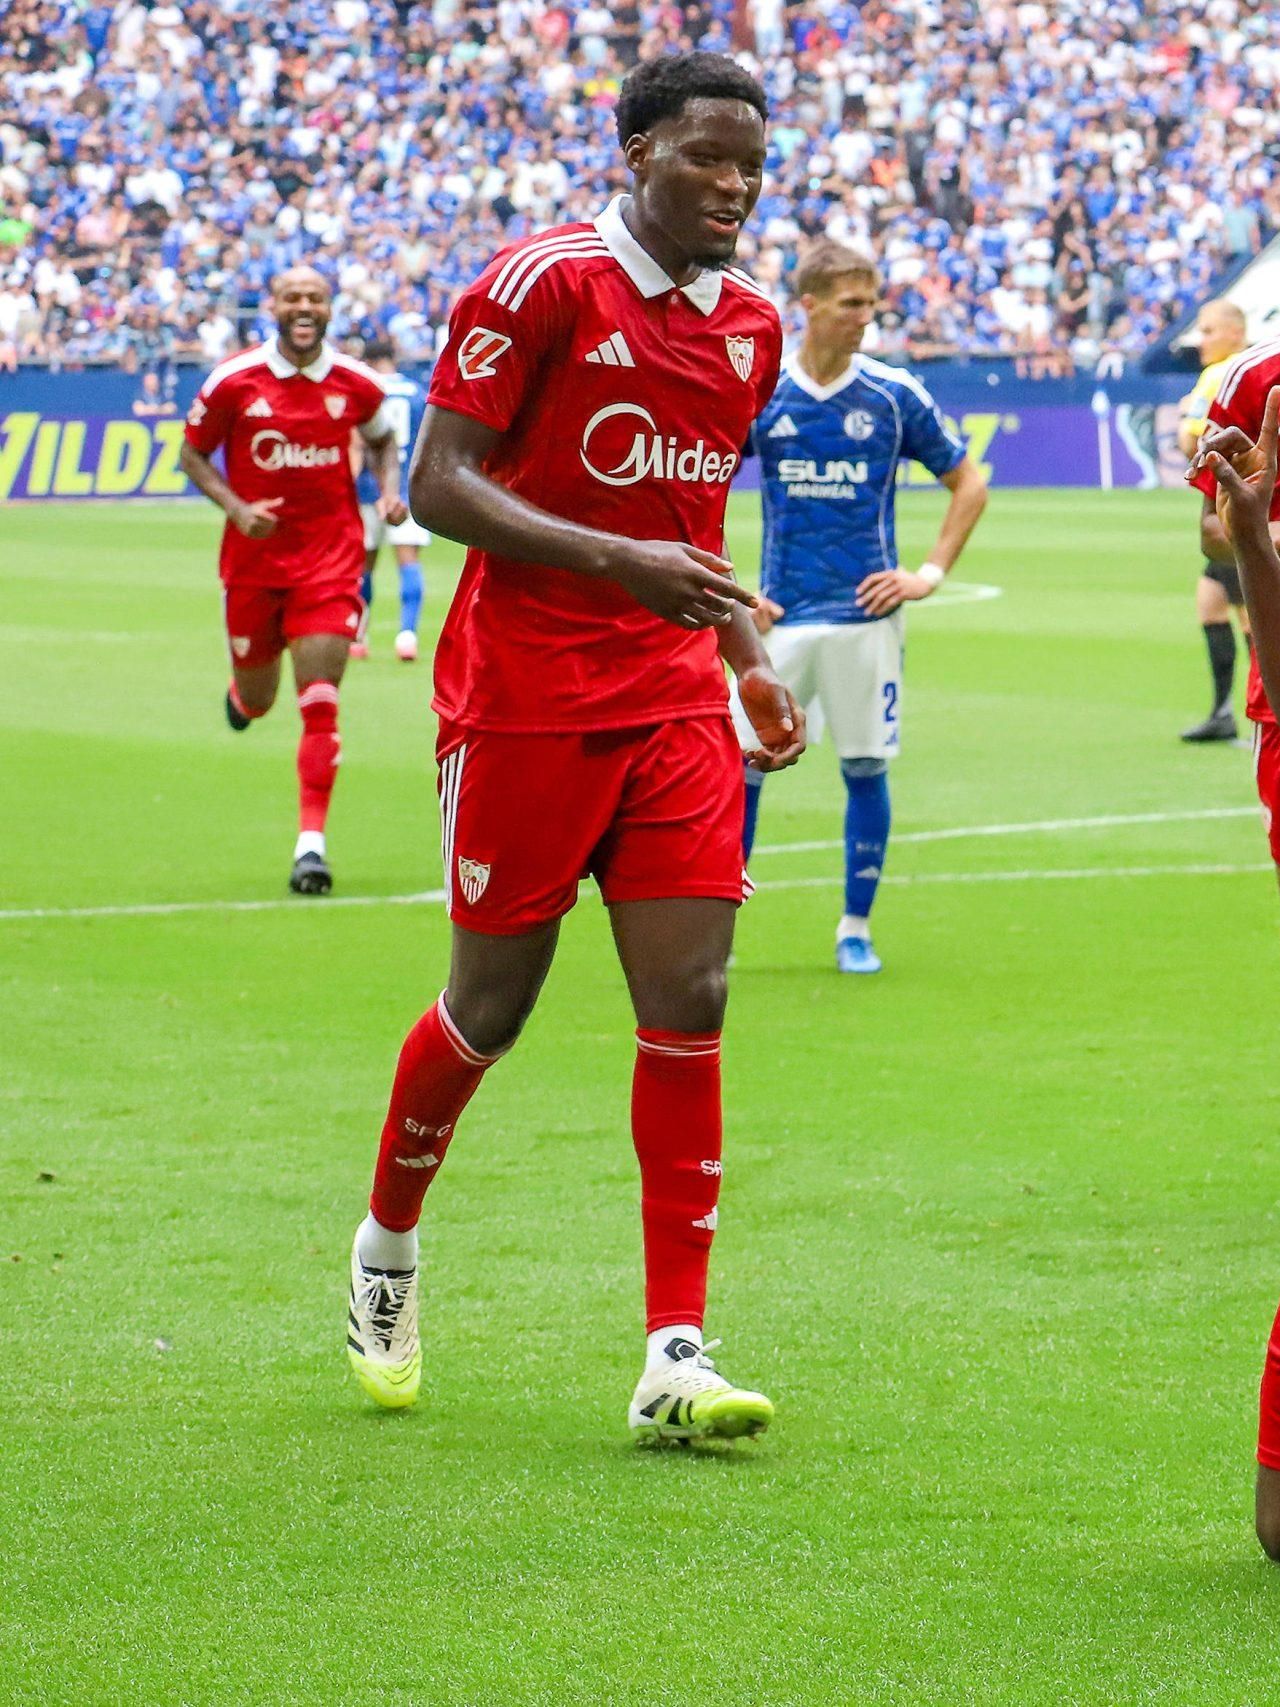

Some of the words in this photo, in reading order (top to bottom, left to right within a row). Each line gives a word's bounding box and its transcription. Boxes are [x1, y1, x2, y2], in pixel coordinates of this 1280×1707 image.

[579, 433, 739, 486] Midea
[778, 459, 868, 483] SUN
[882, 681, 897, 722] 2
